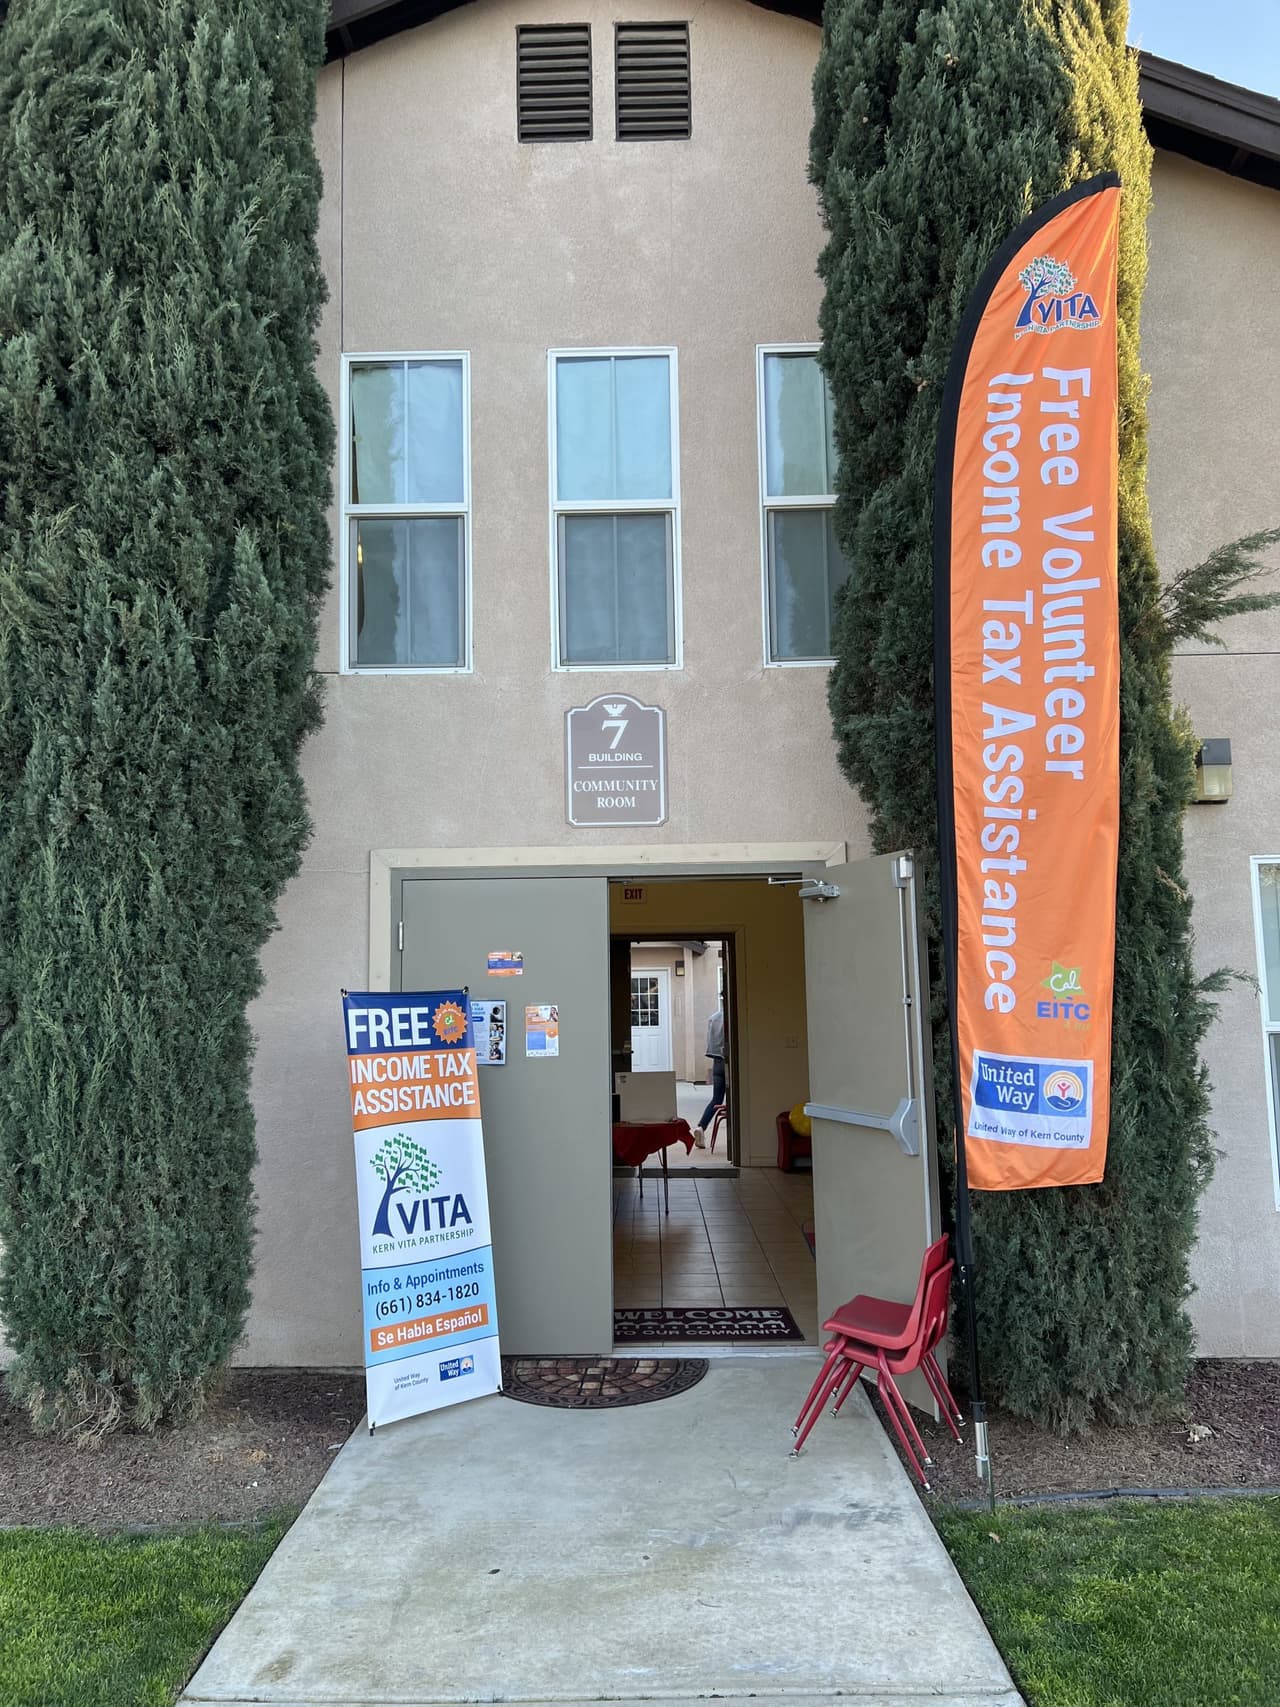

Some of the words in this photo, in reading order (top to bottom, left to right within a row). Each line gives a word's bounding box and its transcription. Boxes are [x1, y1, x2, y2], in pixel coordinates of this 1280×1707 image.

[1038, 293, 1099, 323] VITA
[1040, 367, 1091, 486] Free
[981, 372, 1034, 568] Income
[981, 589, 1034, 685] Tax
[1041, 504, 1101, 780] Volunteer
[601, 719, 629, 750] 7
[588, 752, 643, 762] BUILDING
[573, 779, 658, 792] COMMUNITY
[597, 796, 636, 808] ROOM
[980, 701, 1037, 1014] Assistance
[624, 888, 643, 900] EXIT
[1050, 970, 1081, 992] Cal
[1037, 1001, 1090, 1021] EITC
[347, 1006, 431, 1049] FREE
[351, 1055, 432, 1084] INCOME
[434, 1052, 473, 1077] TAX
[981, 1062, 1035, 1087] United
[353, 1081, 476, 1116] ASSISTANCE
[997, 1086, 1035, 1111] Way
[974, 1121, 998, 1134] United
[1001, 1126, 1017, 1138] Way
[1019, 1128, 1028, 1137] of
[1030, 1130, 1051, 1140] Kern
[1053, 1132, 1085, 1143] County
[396, 1193, 472, 1235] VITA
[372, 1242, 395, 1254] KERN
[398, 1237, 417, 1249] VITA
[419, 1228, 474, 1245] PARTNERSHIP
[367, 1279, 390, 1296] Info
[394, 1277, 402, 1290] &
[406, 1262, 484, 1290] Appointments
[375, 1296, 412, 1320] (661)
[416, 1282, 480, 1308] 834-1820
[614, 1310, 783, 1320] WELCOME
[377, 1331, 394, 1346] Se
[397, 1324, 433, 1342] Habla
[436, 1309, 482, 1332] Español
[686, 1328, 791, 1336] COMMUNITY
[440, 1359, 459, 1372] United
[447, 1368, 459, 1377] Way
